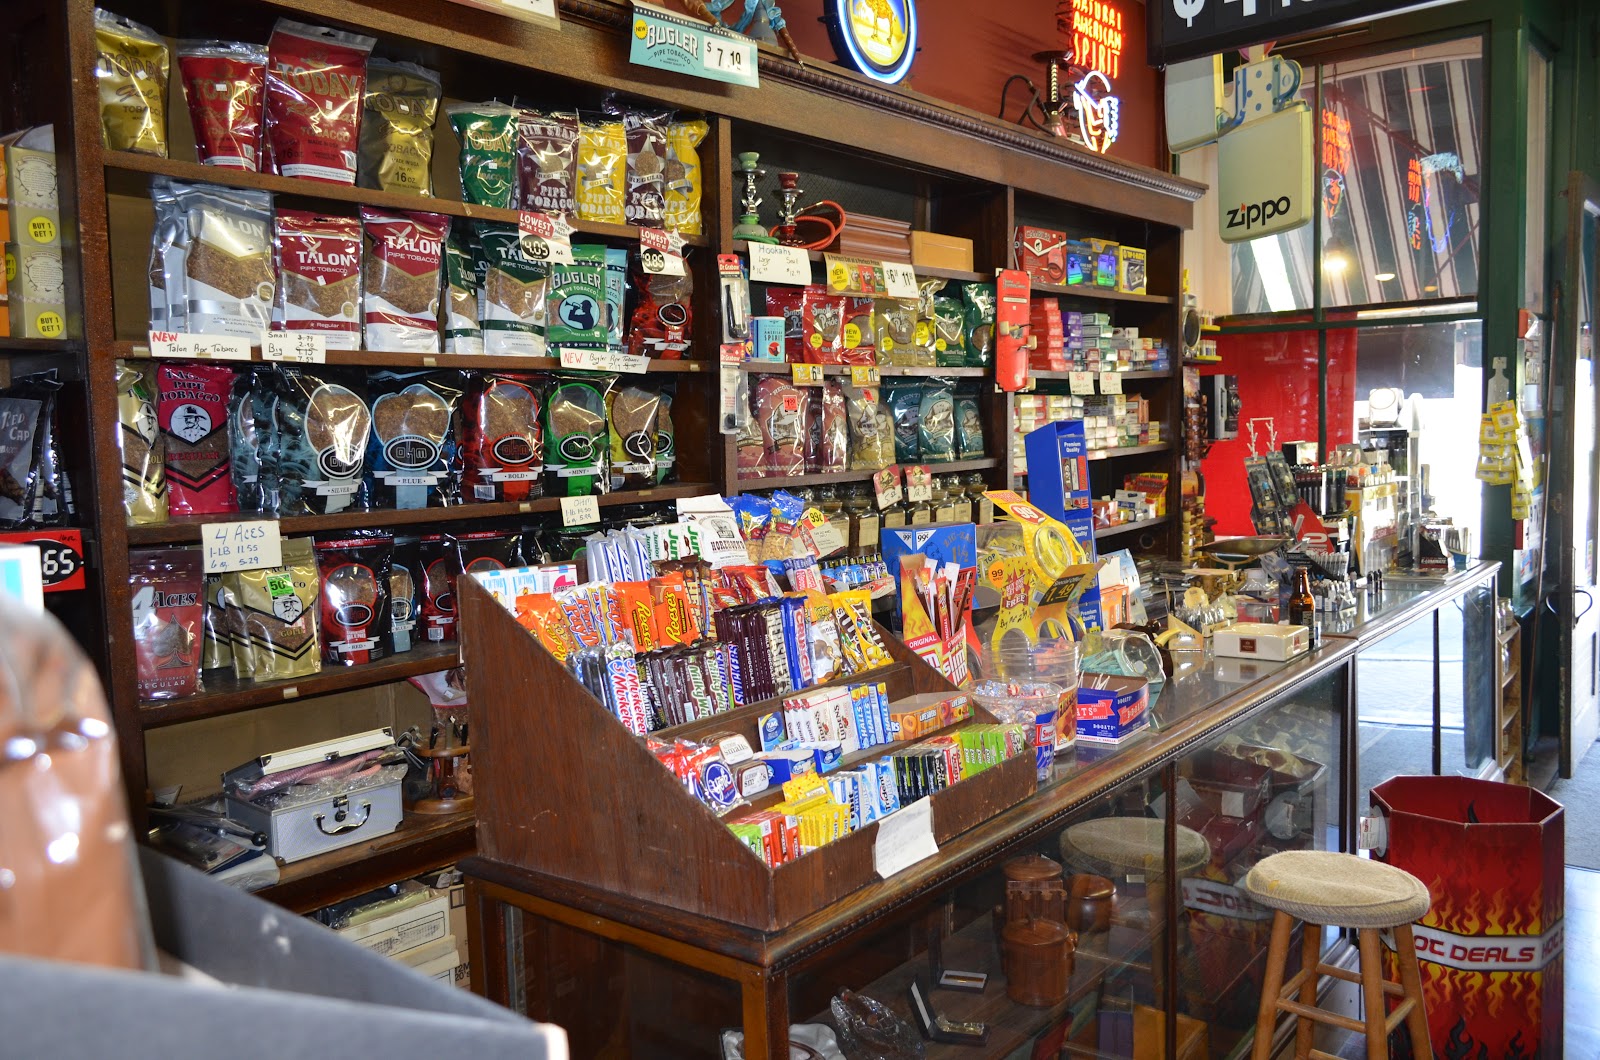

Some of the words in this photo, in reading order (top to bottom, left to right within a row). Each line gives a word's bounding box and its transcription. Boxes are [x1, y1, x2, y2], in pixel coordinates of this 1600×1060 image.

[1073, 11, 1121, 50] AMERICAN
[646, 24, 699, 60] BUGLER
[654, 48, 666, 58] PIPE
[666, 48, 691, 64] TOBACCO
[1074, 33, 1120, 78] SPIRIT
[276, 63, 360, 99] TODAY
[395, 171, 407, 182] 16
[628, 174, 664, 184] REGULAR
[540, 185, 567, 198] PIPE
[32, 222, 46, 230] BUY
[520, 212, 552, 232] LOWEST
[34, 230, 47, 238] GET
[642, 230, 666, 244] LOWEST
[384, 235, 441, 256] TALON
[758, 244, 790, 256] Hookahs
[296, 250, 351, 267] TALON
[406, 253, 440, 264] TOBACCO
[317, 266, 348, 274] TOBACCO
[517, 263, 546, 274] TOBACCO
[552, 271, 600, 290] BUGLER
[605, 277, 621, 298] LER
[316, 322, 340, 330] Regular
[818, 316, 838, 330] Pride
[152, 332, 178, 342] NEW
[764, 334, 783, 342] SPIRIT
[166, 343, 187, 352] Talon
[268, 342, 282, 356] Big
[564, 352, 582, 364] NEW
[590, 353, 606, 366] Bugler
[174, 382, 205, 391] PIPE
[160, 392, 220, 402] TOBACCO
[1, 410, 26, 430] RED
[10, 426, 30, 442] CAP
[215, 528, 228, 544] 4
[234, 524, 265, 543] ACES
[1072, 524, 1088, 532] Premium
[1074, 530, 1088, 538] Quality
[669, 528, 679, 560] Jun
[687, 526, 702, 560] Jun
[984, 553, 997, 564] TOP
[150, 591, 197, 608] ACES
[1006, 594, 1026, 608] FREE
[666, 592, 682, 642] Reese's
[794, 608, 812, 682] CRUNCH
[909, 635, 937, 648] ORIGINAL
[613, 662, 621, 672] 3
[729, 644, 744, 704] SNICKERS
[746, 651, 756, 688] CHOCOLATE
[688, 664, 706, 699] Milky
[698, 697, 710, 720] Wa
[612, 674, 634, 732] Musketee
[627, 673, 646, 734] Musketeer
[856, 706, 868, 738] HALLS
[864, 702, 874, 734] HALLS
[882, 700, 892, 730] HALLS
[724, 744, 748, 755] smalls
[1450, 944, 1536, 962] DEALS
